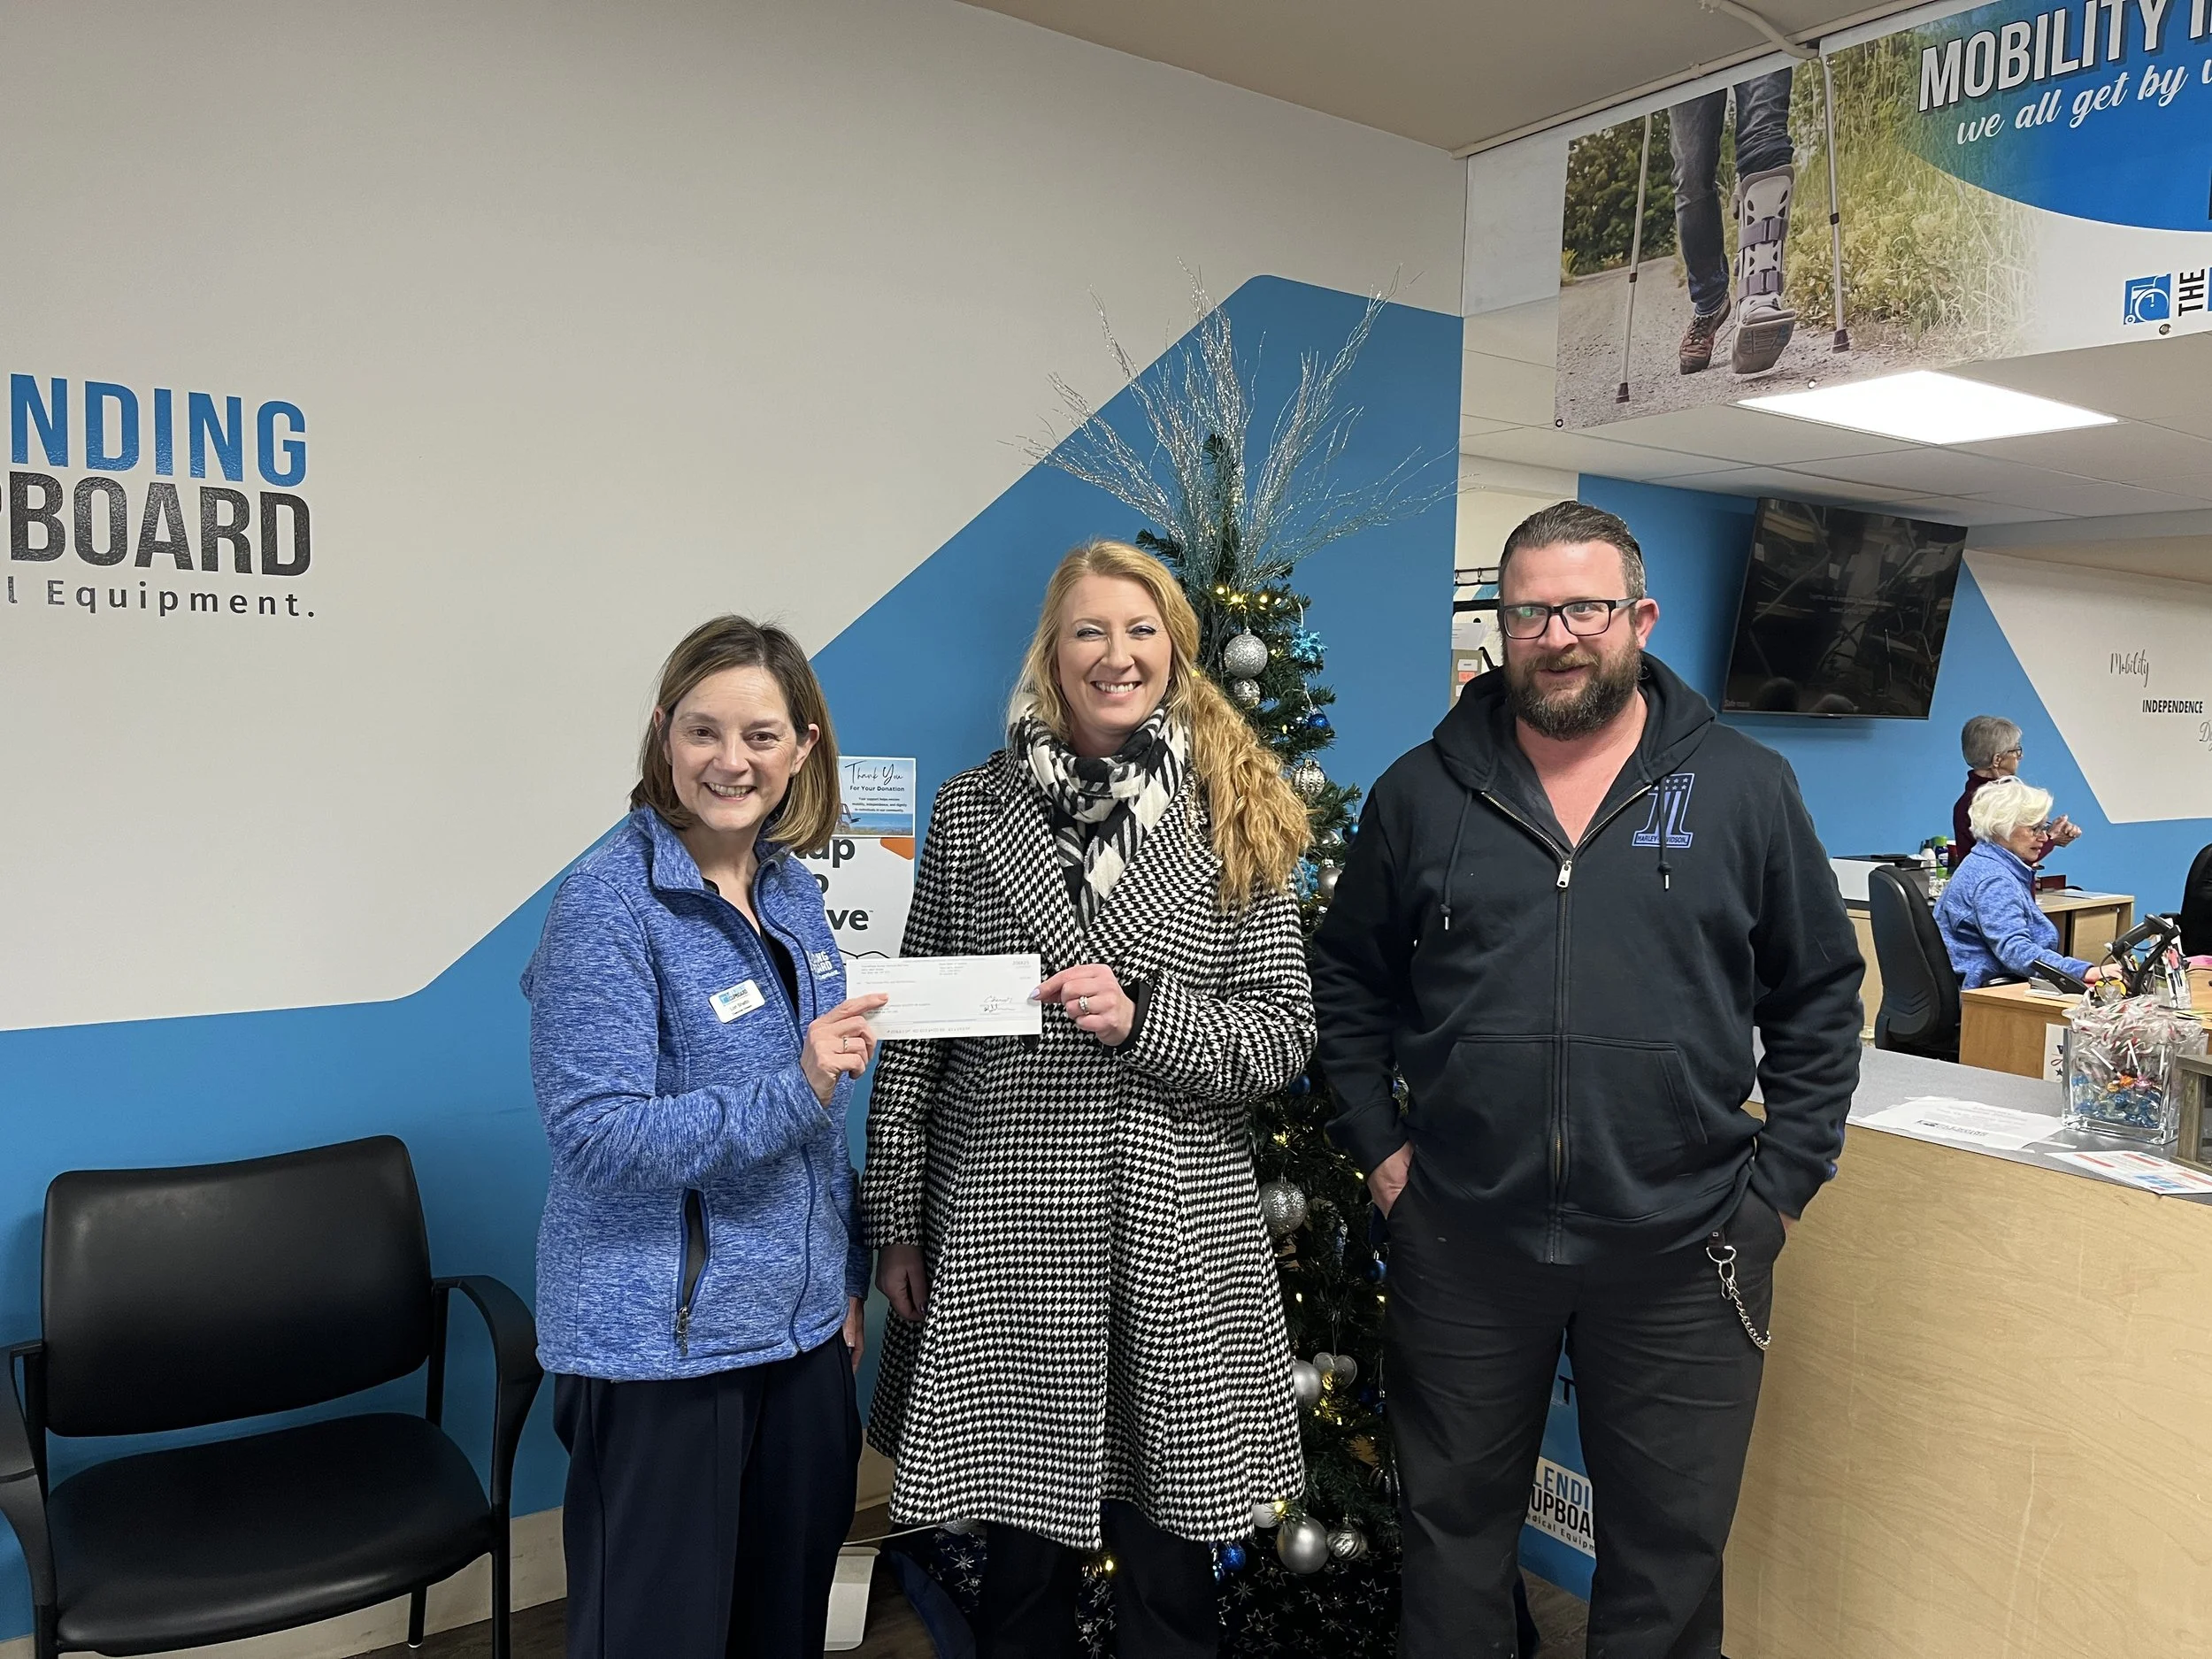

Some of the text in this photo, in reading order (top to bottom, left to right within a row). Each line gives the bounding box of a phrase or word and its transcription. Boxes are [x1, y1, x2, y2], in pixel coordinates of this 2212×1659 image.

[1918, 0, 2168, 112] MOBILITY
[1956, 113, 2004, 145] we
[2015, 89, 2062, 129] all
[2070, 72, 2129, 129] get
[2137, 65, 2189, 107] by
[2178, 269, 2205, 317] THE
[11, 373, 307, 488] NDING
[0, 471, 311, 577] BOARD
[47, 580, 315, 618] Equipment.
[2110, 649, 2149, 687] Mobility
[2142, 700, 2203, 713] INDEPENDENCE
[845, 760, 903, 786] Thank You
[796, 838, 855, 868] ap
[826, 908, 870, 931] ve
